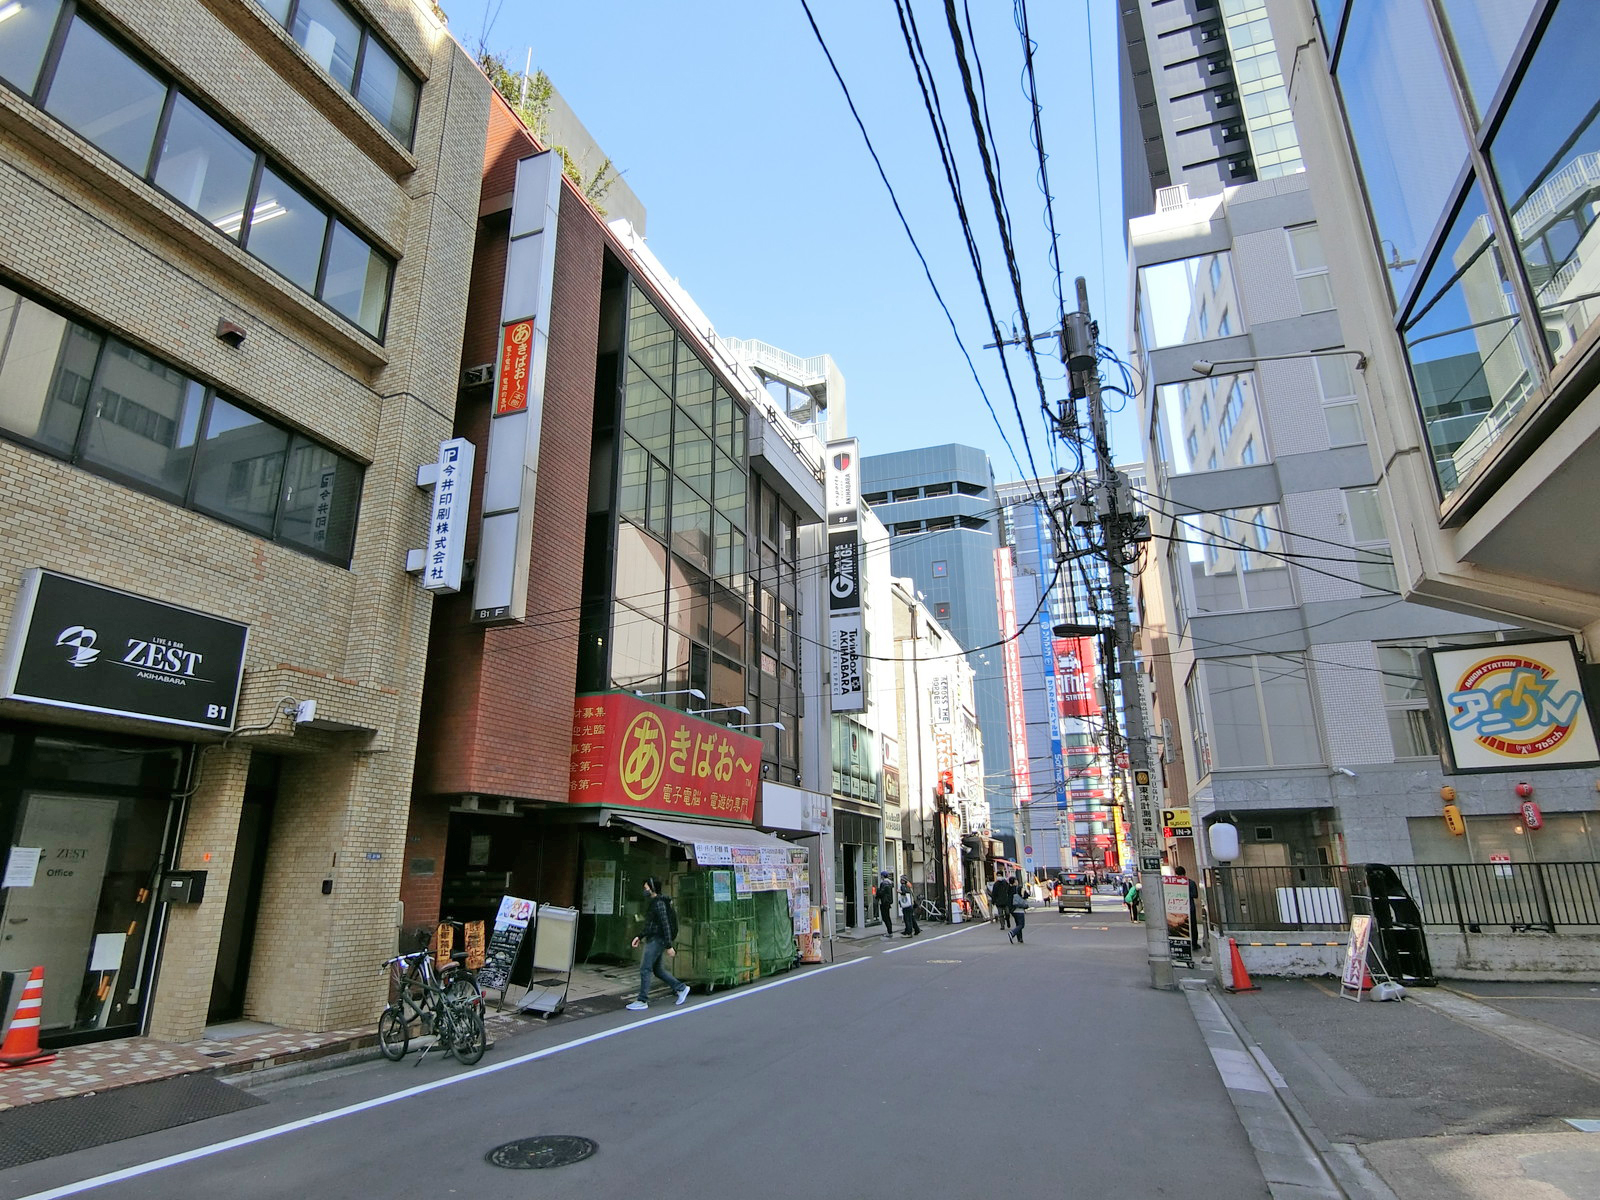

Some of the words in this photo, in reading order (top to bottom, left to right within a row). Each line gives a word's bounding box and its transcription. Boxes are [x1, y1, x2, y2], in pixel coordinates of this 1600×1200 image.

[431, 464, 456, 580] 今井印刷株式会社
[831, 543, 854, 599] GARAGE
[480, 610, 490, 619] B1
[495, 608, 505, 617] F
[152, 637, 166, 646] LIVE
[172, 641, 184, 649] BAR
[123, 638, 203, 677] ZEST
[840, 630, 850, 696] AKIHABARA
[1482, 660, 1517, 673] STATION
[136, 671, 187, 686] AKIHABARA
[206, 703, 228, 720] B1
[1535, 731, 1563, 750] 765ch
[1163, 811, 1175, 826] P
[1175, 828, 1185, 836] IN
[56, 848, 89, 860] ZEST
[46, 868, 74, 878] Office
